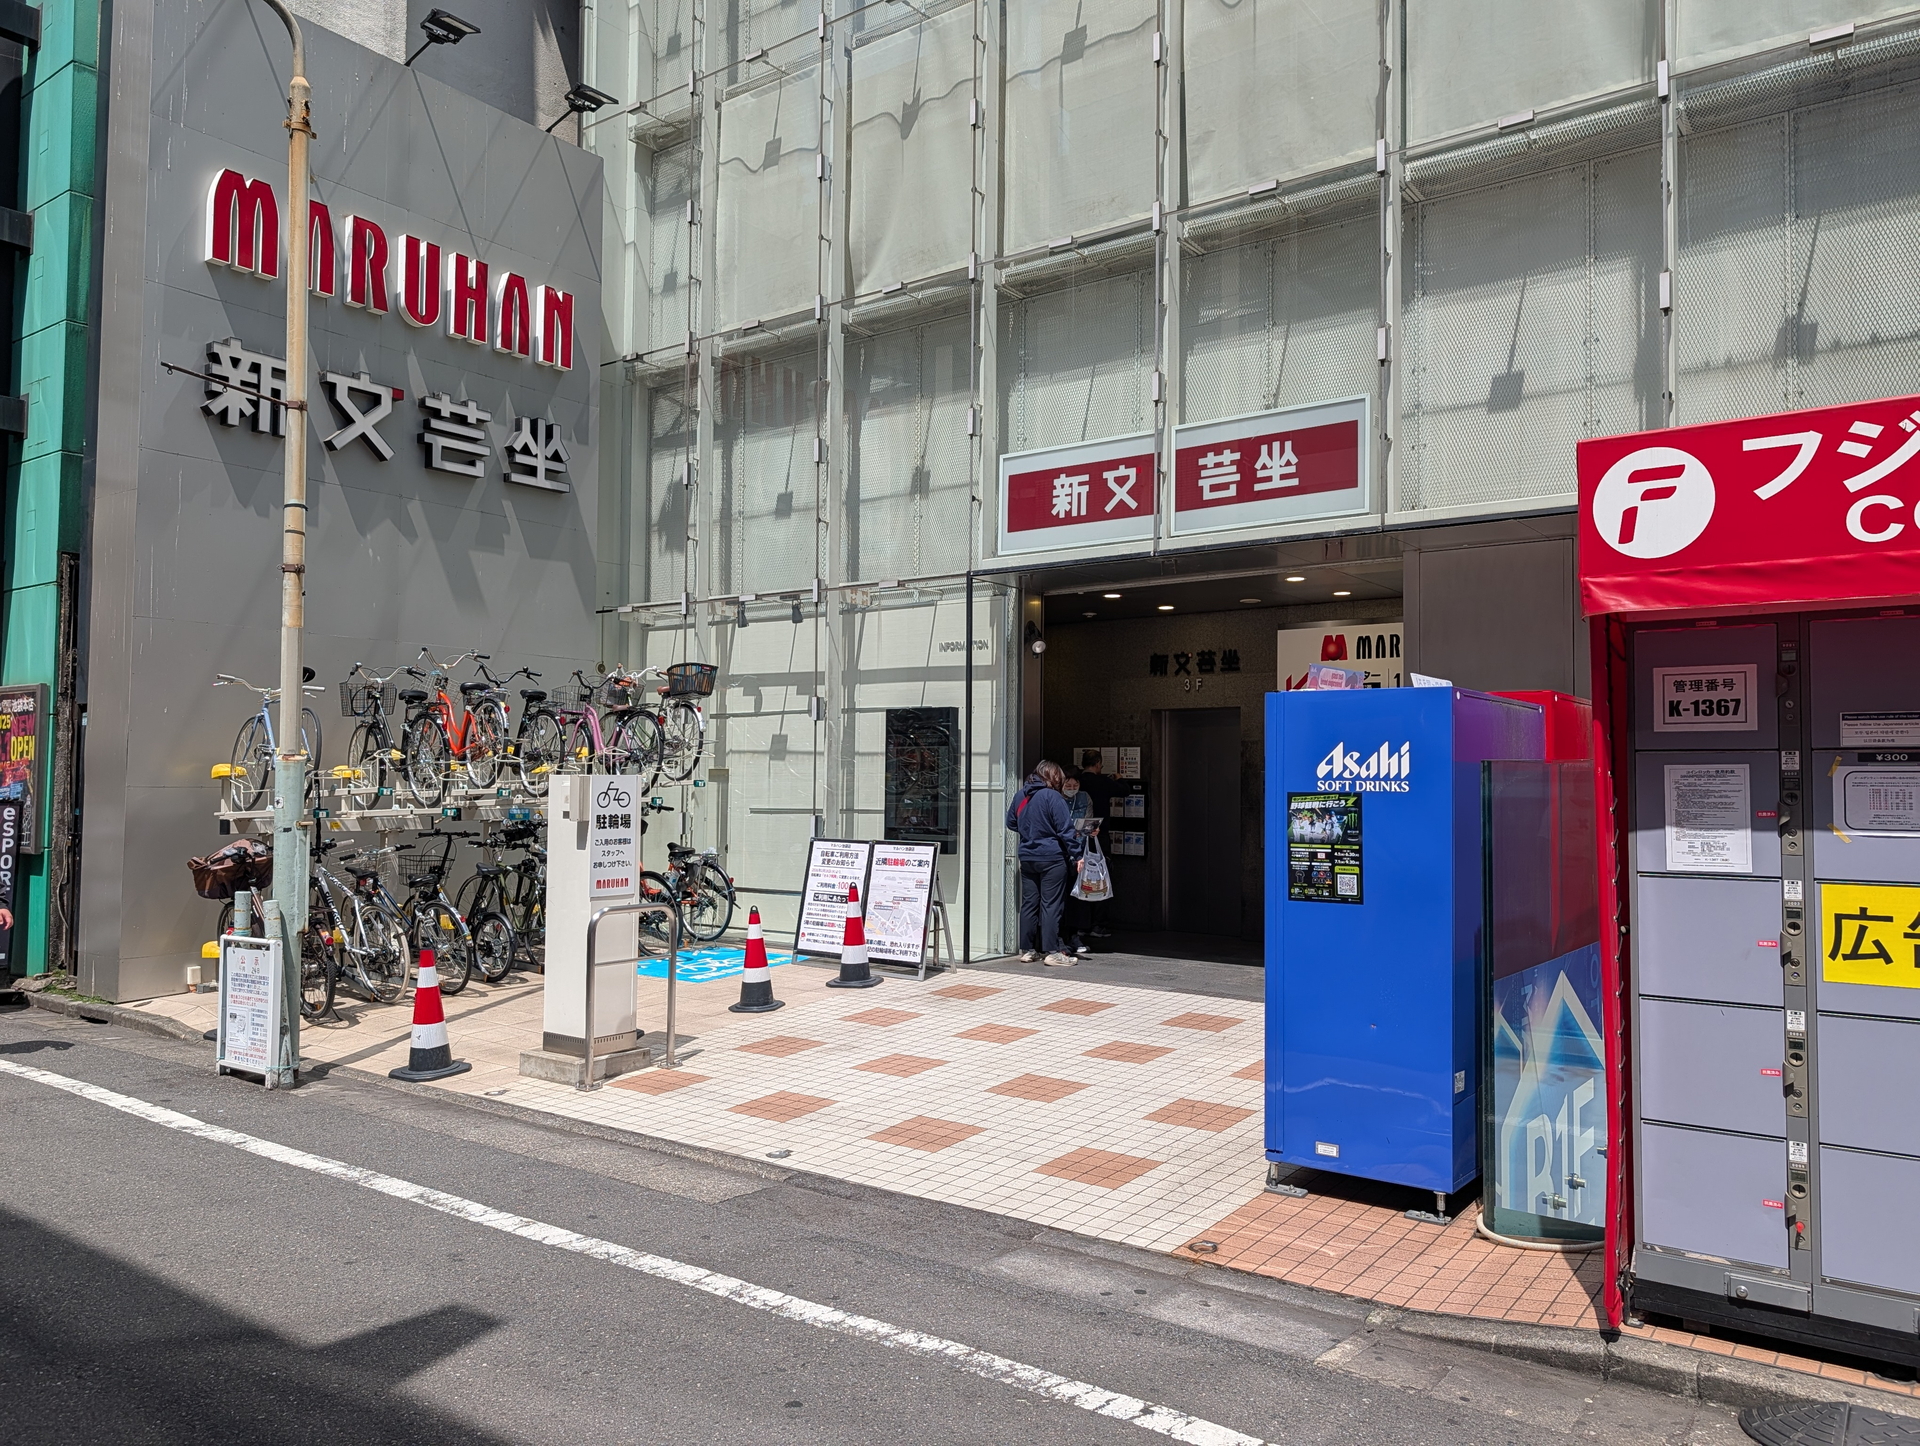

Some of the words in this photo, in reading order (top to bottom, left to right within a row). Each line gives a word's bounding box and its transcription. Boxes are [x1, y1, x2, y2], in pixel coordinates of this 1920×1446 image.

[205, 168, 575, 372] MARUHAN
[200, 337, 571, 494] 新文芸坐
[1845, 494, 1920, 543] C
[1149, 648, 1242, 677] 新文芸坐
[1672, 678, 1737, 694] 管理番号
[1668, 698, 1742, 718] K-1367
[11, 735, 35, 761] OPEN
[1316, 740, 1411, 779] Asahi
[1876, 753, 1909, 762] ¥300
[1317, 780, 1352, 792] SOFT
[1355, 780, 1410, 793] DRINKS
[595, 813, 631, 830] 駐輪場
[0, 807, 16, 891] eSPOR
[594, 838, 631, 847] ご入用のお客様は
[601, 849, 625, 857] スタッフへ
[820, 850, 859, 860] 自転車ご利用方法
[821, 858, 856, 867] 変更のお知らせ
[875, 857, 930, 869] 近隣駐輪場のご案内
[595, 877, 629, 890] MARUHAN
[1828, 906, 1920, 969] 広
